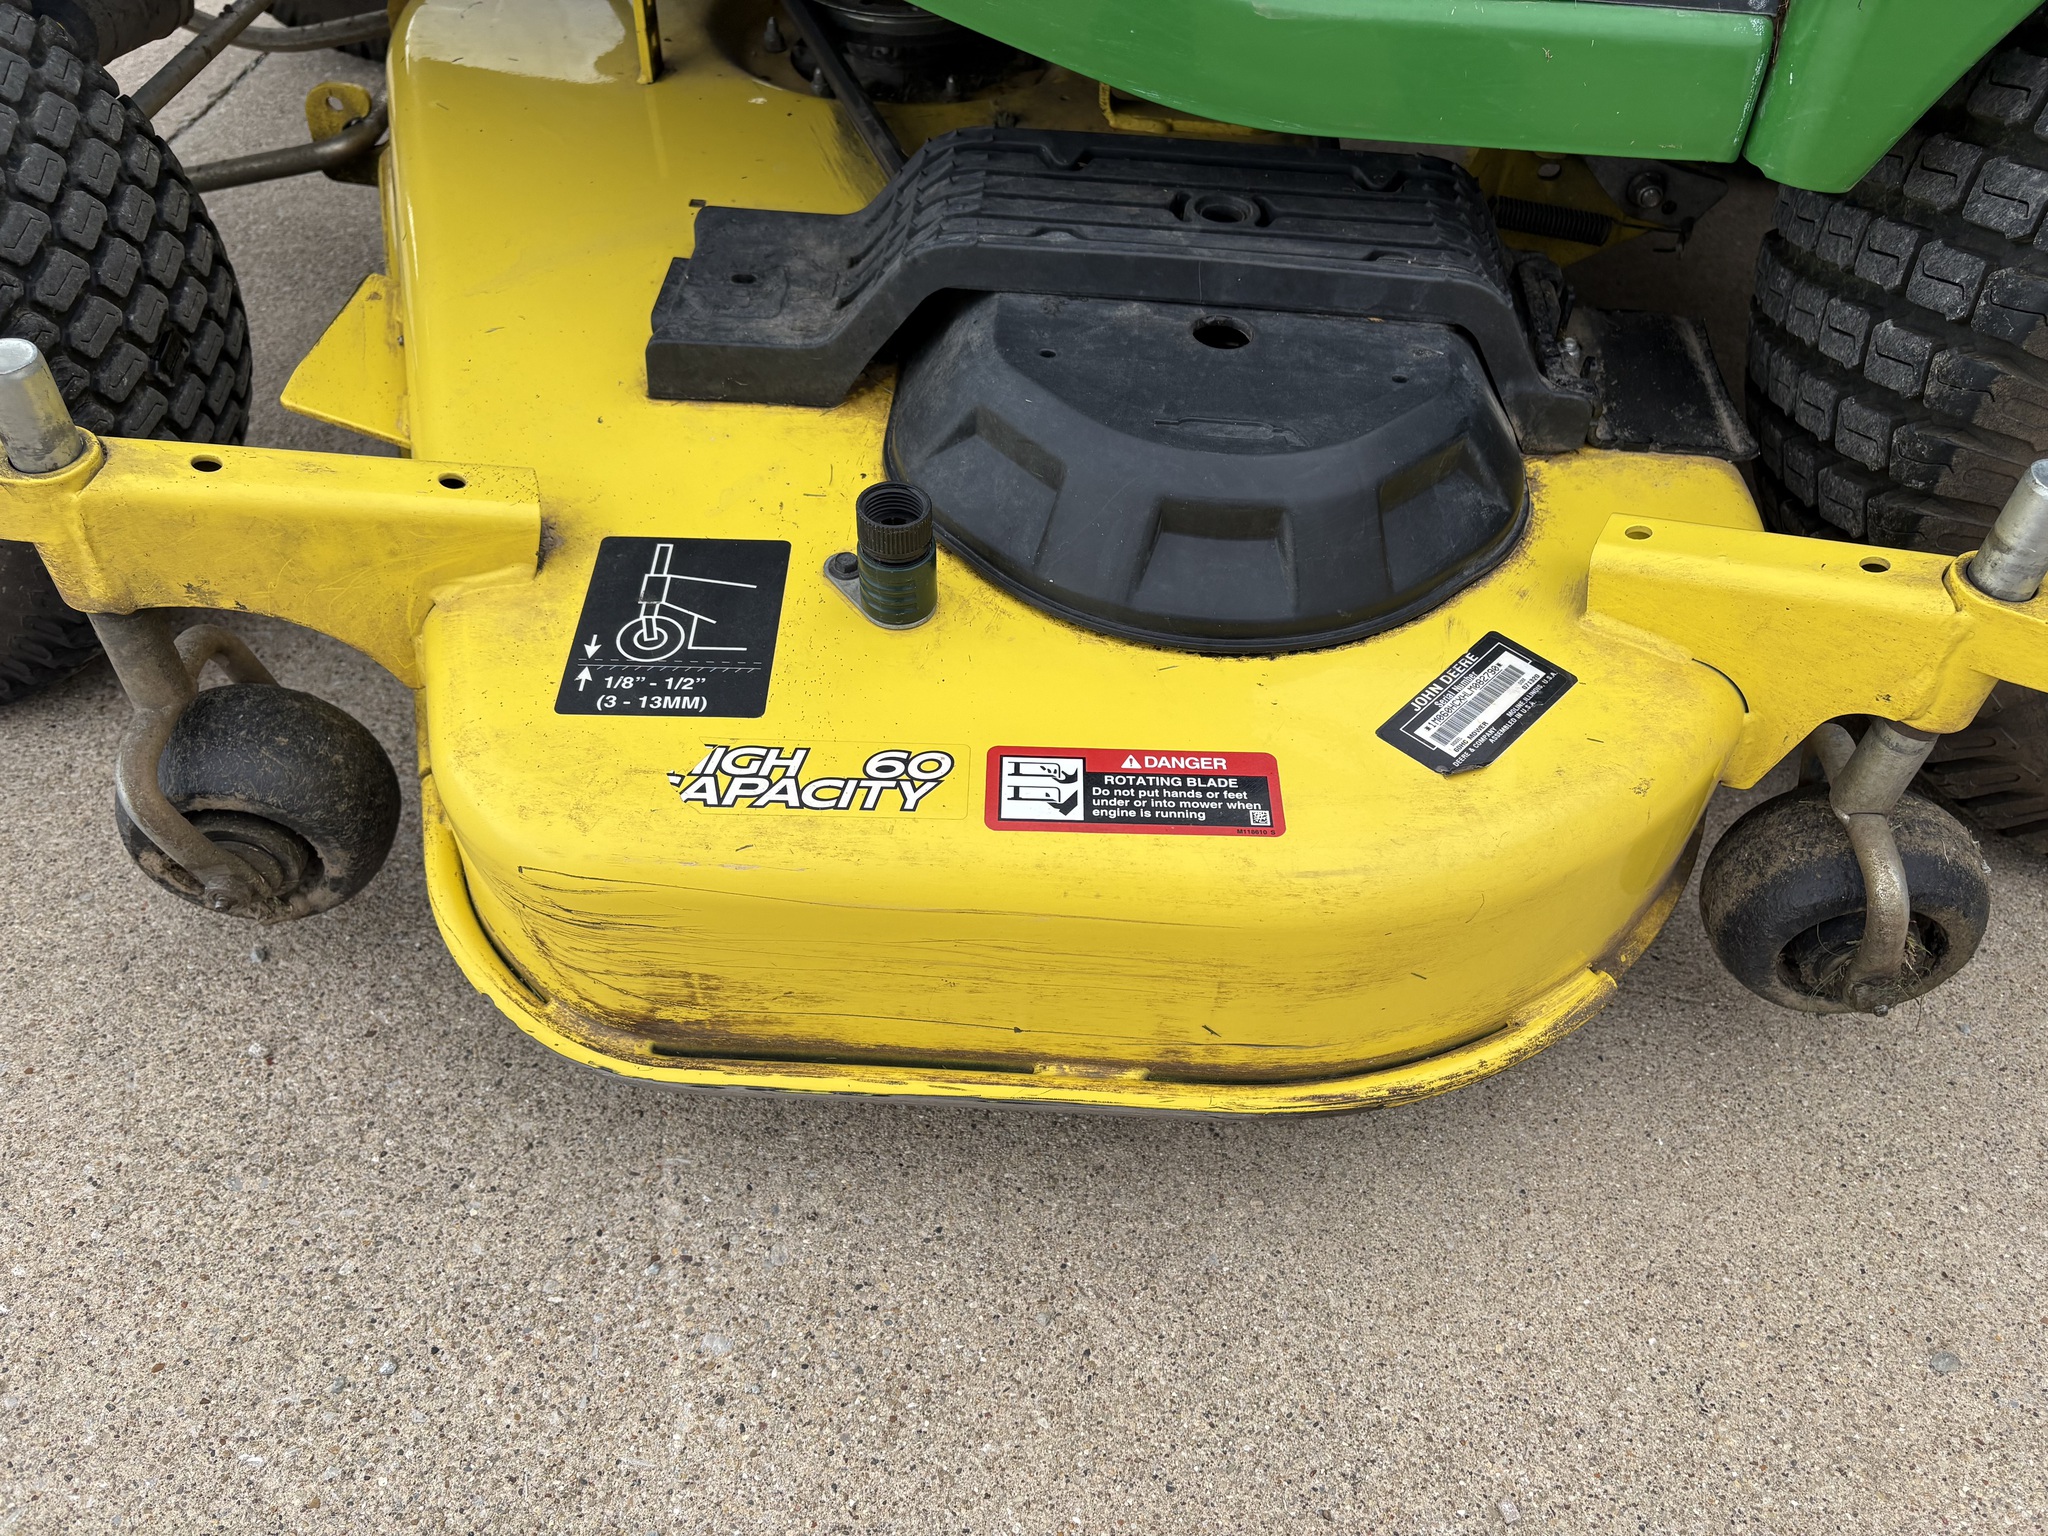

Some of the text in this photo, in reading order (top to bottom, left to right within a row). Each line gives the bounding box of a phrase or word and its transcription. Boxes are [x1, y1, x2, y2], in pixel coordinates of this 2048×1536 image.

[1411, 653, 1479, 712] JOHN DEERE
[1434, 671, 1478, 708] Serial Number
[596, 694, 618, 711] (3
[639, 695, 708, 713] 13MM)
[1453, 752, 1470, 767] DEERE
[1473, 727, 1497, 748] COMPANY
[1542, 671, 1558, 684] U.S.A.
[1489, 701, 1537, 744] ASSEMBLED IN U.S.A.
[1467, 721, 1489, 740] MOWER
[863, 750, 955, 780] 60
[1144, 755, 1227, 770] DANGER
[667, 770, 944, 812] APACITY
[1104, 775, 1238, 788] ROTATING BLADE
[1092, 787, 1248, 800] Do not put hands or feet
[1092, 798, 1262, 810] under or into mower when
[1092, 808, 1206, 821] engine is running
